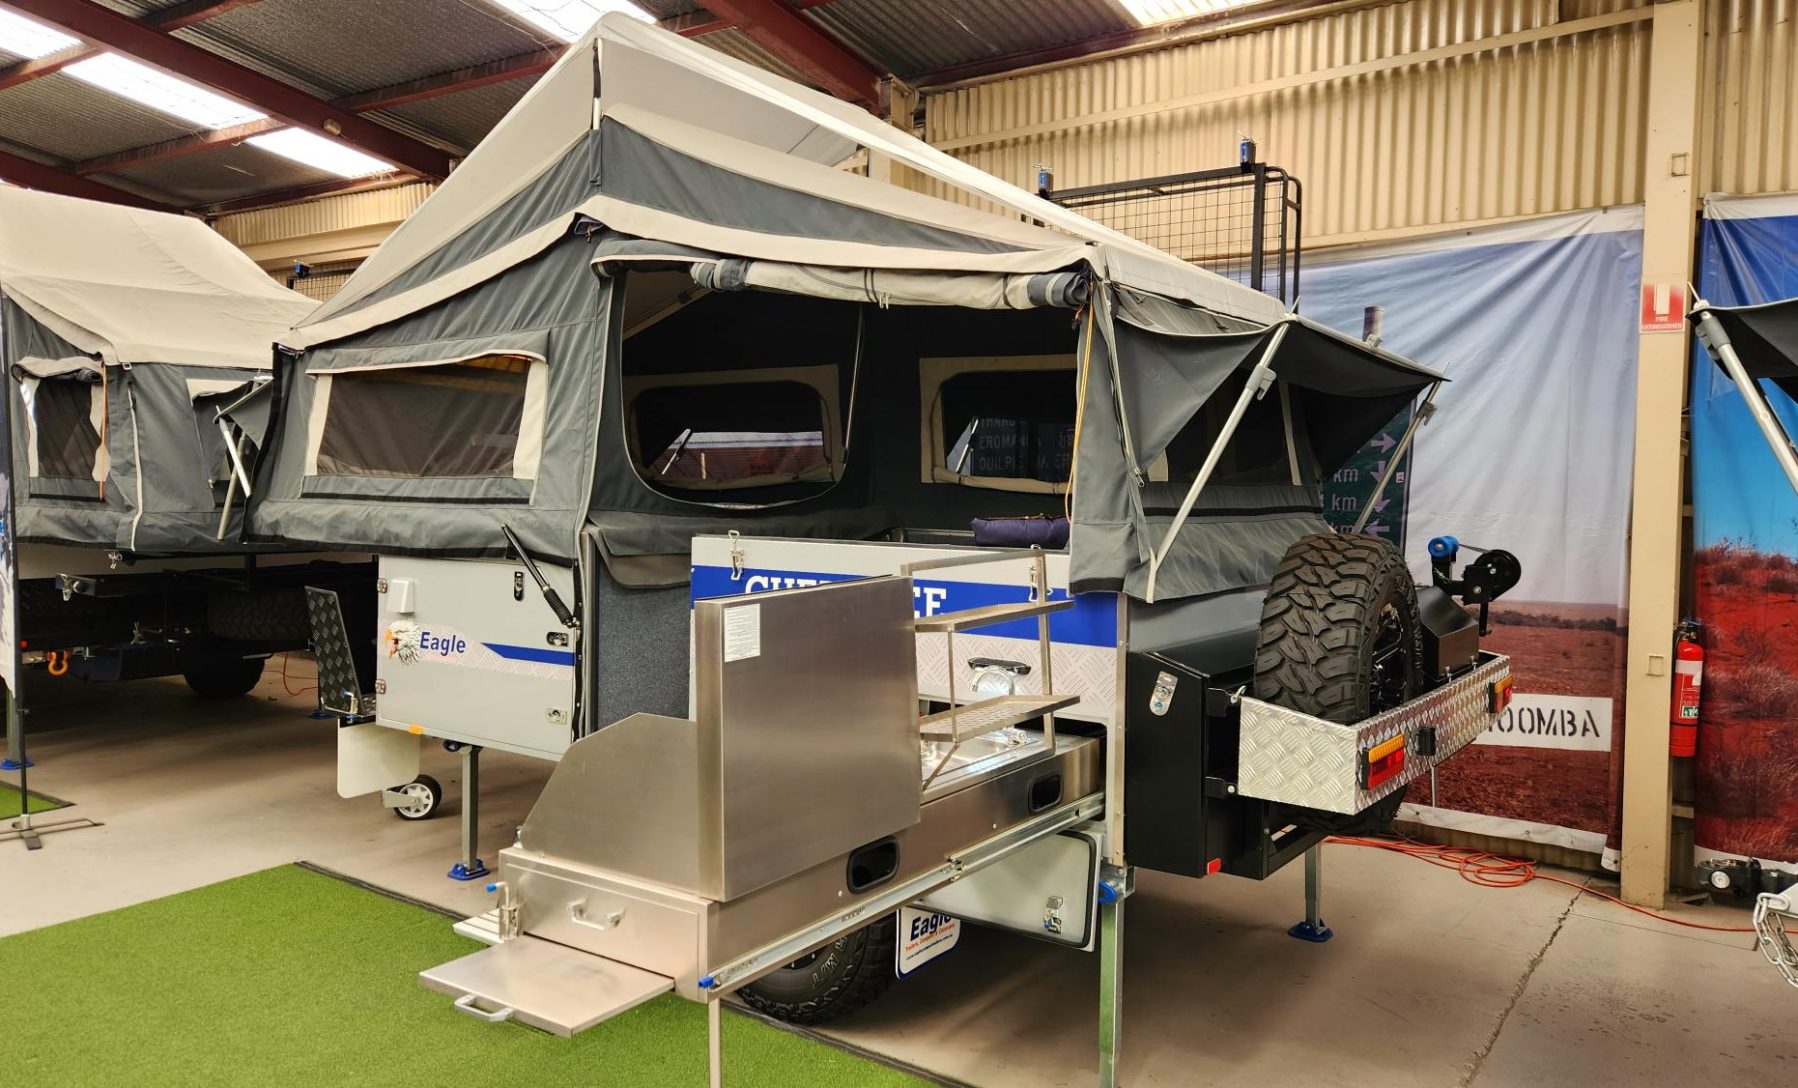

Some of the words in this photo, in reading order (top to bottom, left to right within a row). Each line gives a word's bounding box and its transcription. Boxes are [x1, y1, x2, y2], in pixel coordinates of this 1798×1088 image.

[1331, 493, 1357, 512] km
[419, 631, 466, 656] Eagle
[1489, 706, 1600, 738] OOMBA
